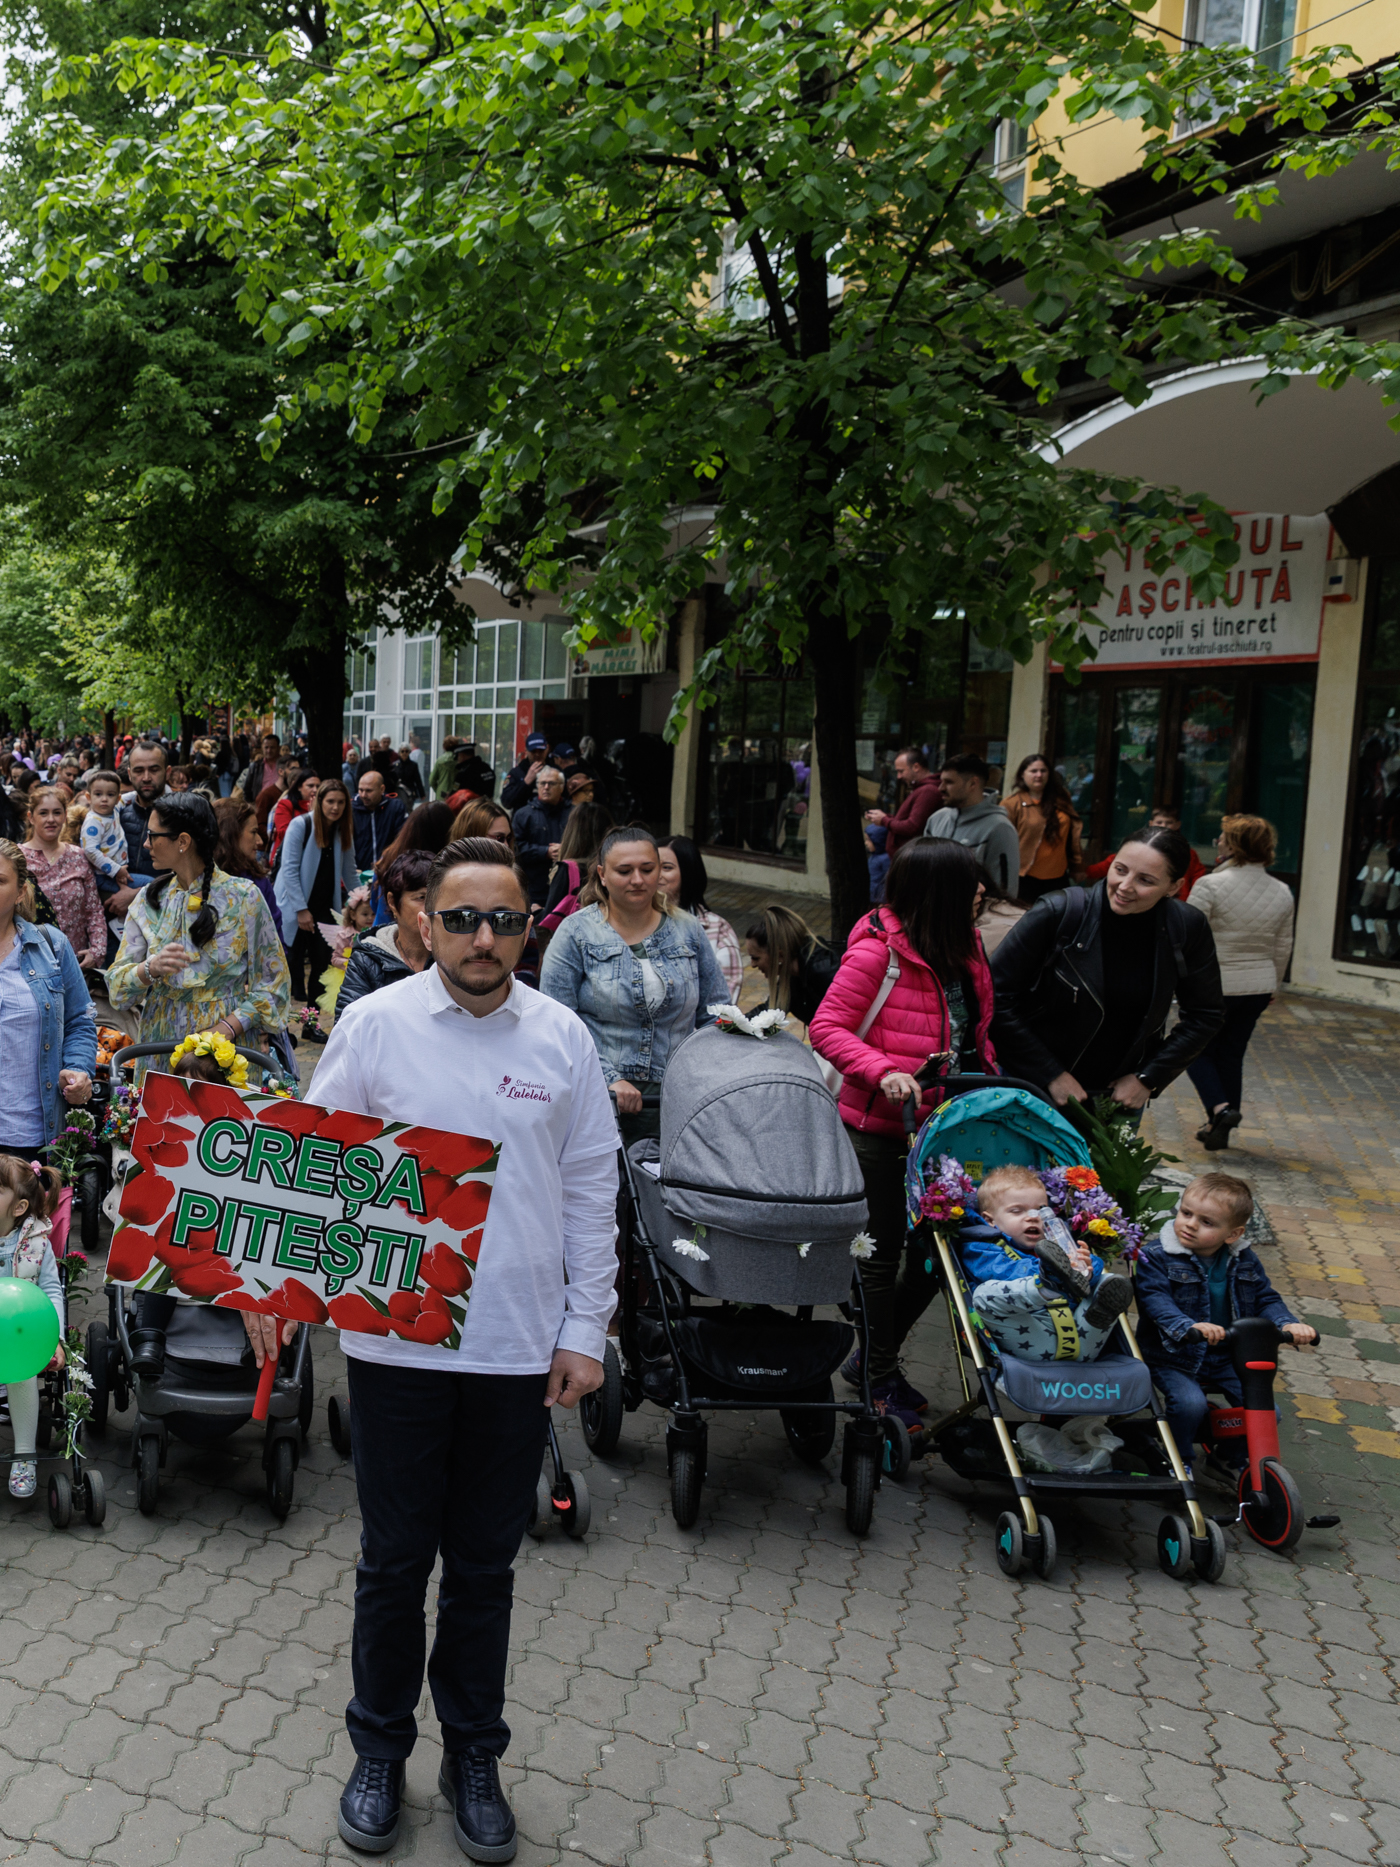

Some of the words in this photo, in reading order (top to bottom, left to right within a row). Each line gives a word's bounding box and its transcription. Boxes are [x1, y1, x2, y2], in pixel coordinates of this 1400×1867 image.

[1099, 623, 1144, 649] pentru
[1147, 620, 1185, 645] copii
[1213, 612, 1277, 637] tineret
[591, 661, 637, 674] MARKET
[514, 1079, 547, 1090] Simfonia
[197, 1116, 427, 1219] CREȘA
[169, 1188, 427, 1297] PITEȘTI
[1041, 1381, 1121, 1400] WOOSH
